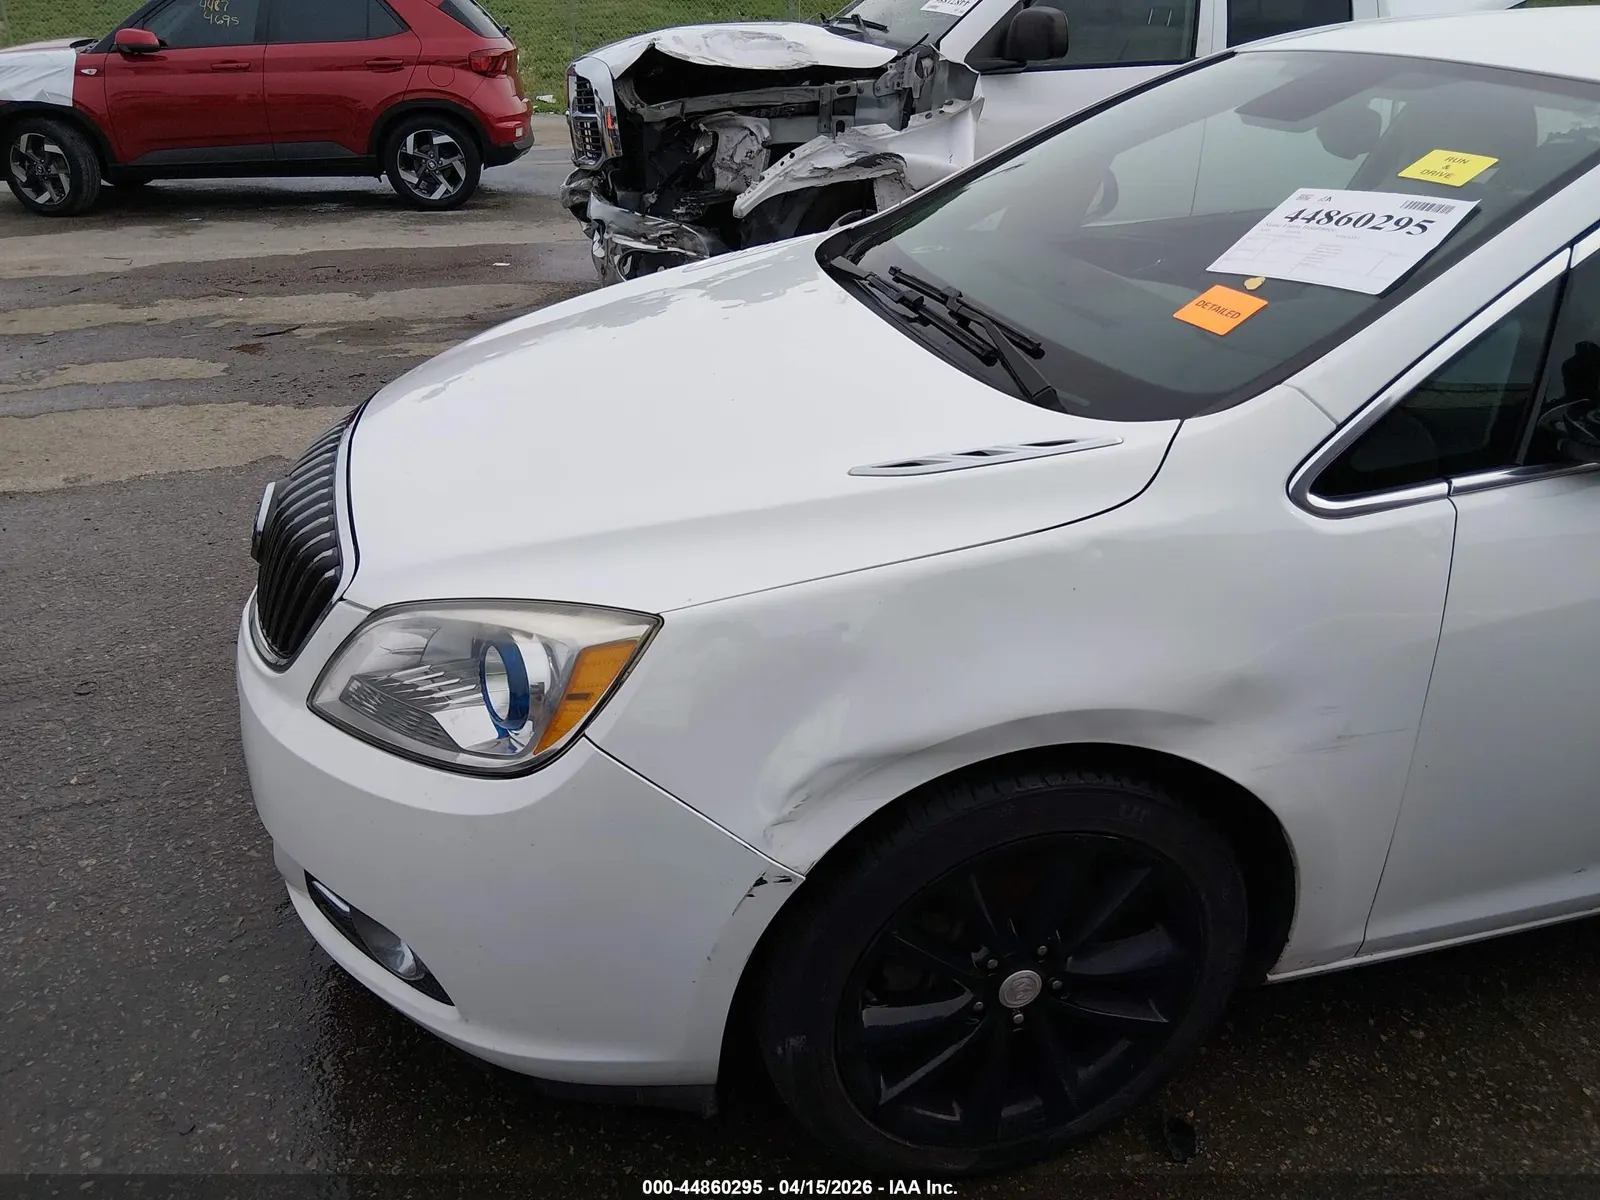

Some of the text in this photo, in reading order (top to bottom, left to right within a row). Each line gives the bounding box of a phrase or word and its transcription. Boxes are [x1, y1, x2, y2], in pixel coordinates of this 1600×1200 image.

[1444, 156, 1470, 165] RUN
[1420, 168, 1455, 179] DRIVE
[1284, 208, 1436, 236] 44860295
[1195, 299, 1242, 320] DETAILED
